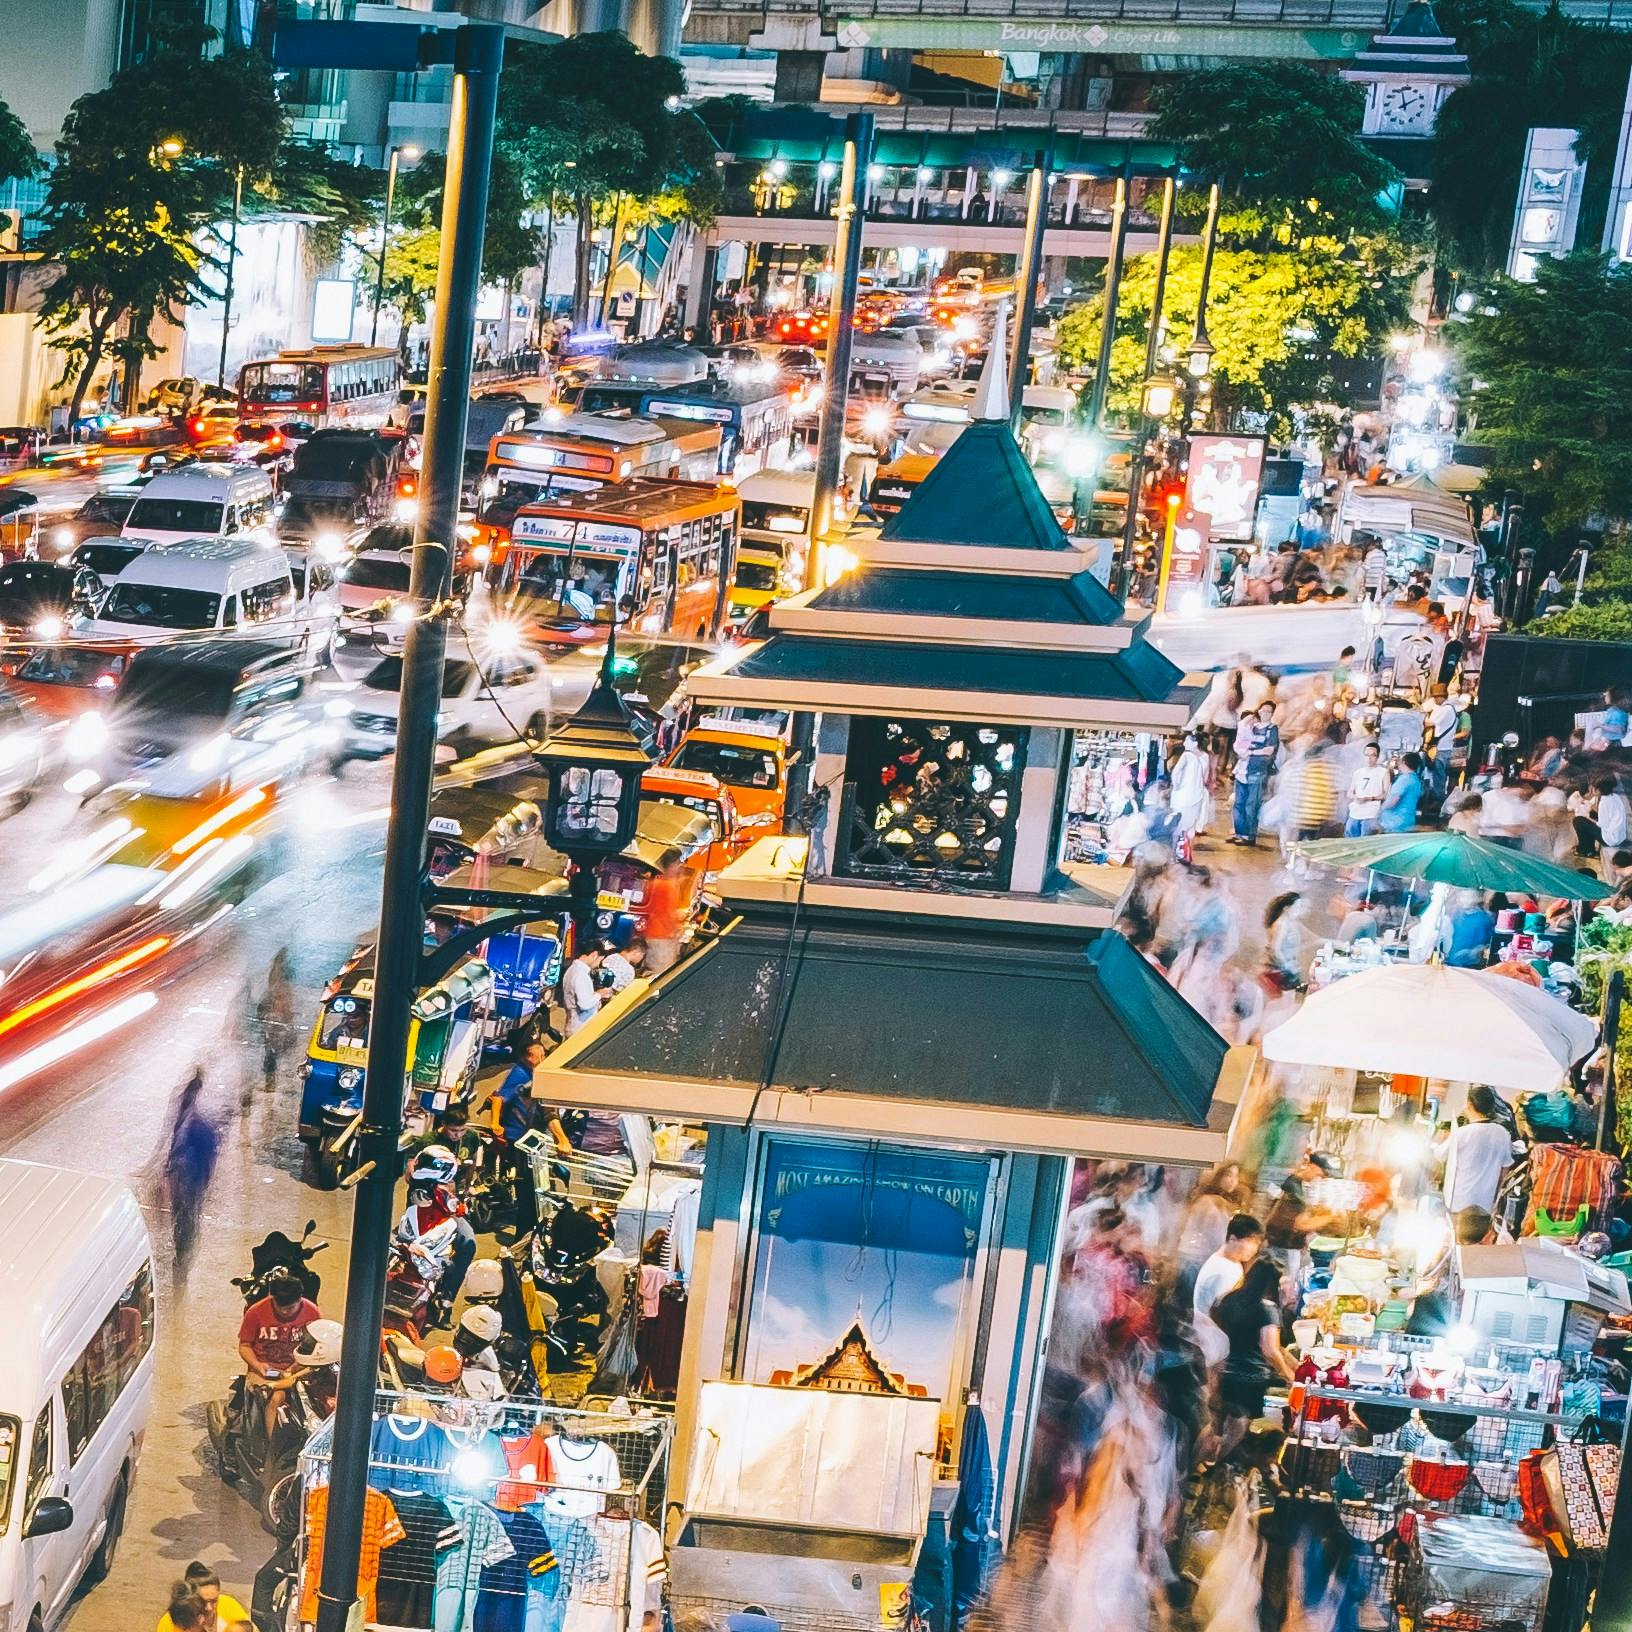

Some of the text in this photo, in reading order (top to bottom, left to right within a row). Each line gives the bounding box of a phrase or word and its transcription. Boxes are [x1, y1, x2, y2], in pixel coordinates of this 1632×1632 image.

[1000, 22, 1081, 47] Bangkok
[1115, 29, 1138, 46] City
[1154, 31, 1182, 44] Life
[1361, 776, 1371, 791] 7
[775, 1170, 809, 1199] MOST
[875, 1178, 911, 1190] SHOW
[914, 1183, 935, 1194] ON
[937, 1186, 979, 1209] EARTH
